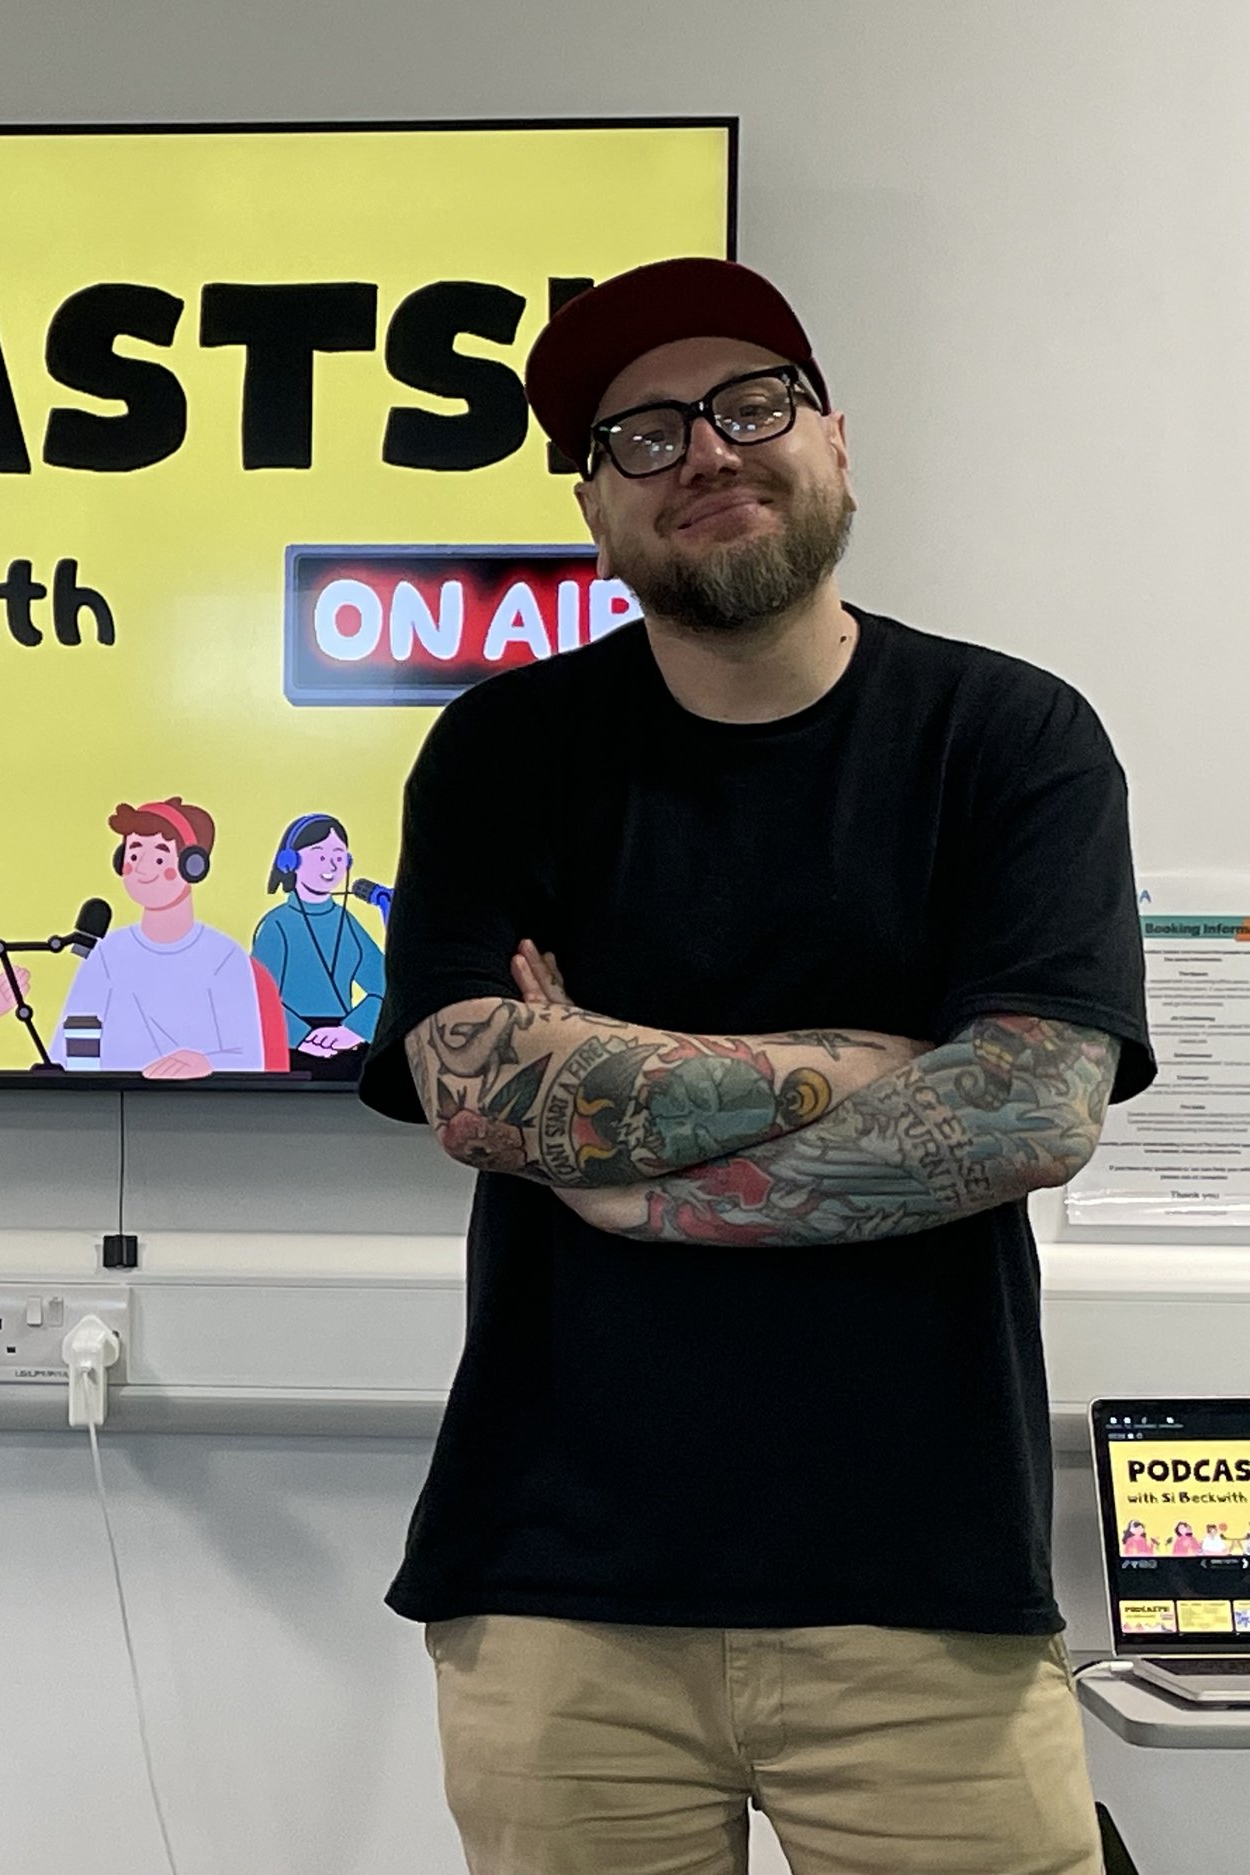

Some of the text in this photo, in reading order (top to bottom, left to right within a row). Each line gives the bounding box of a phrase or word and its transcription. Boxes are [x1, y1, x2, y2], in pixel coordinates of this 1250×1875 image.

[314, 579, 464, 661] ON
[1145, 923, 1200, 937] Booking
[1127, 1491, 1248, 1503] with Si Beckwith
